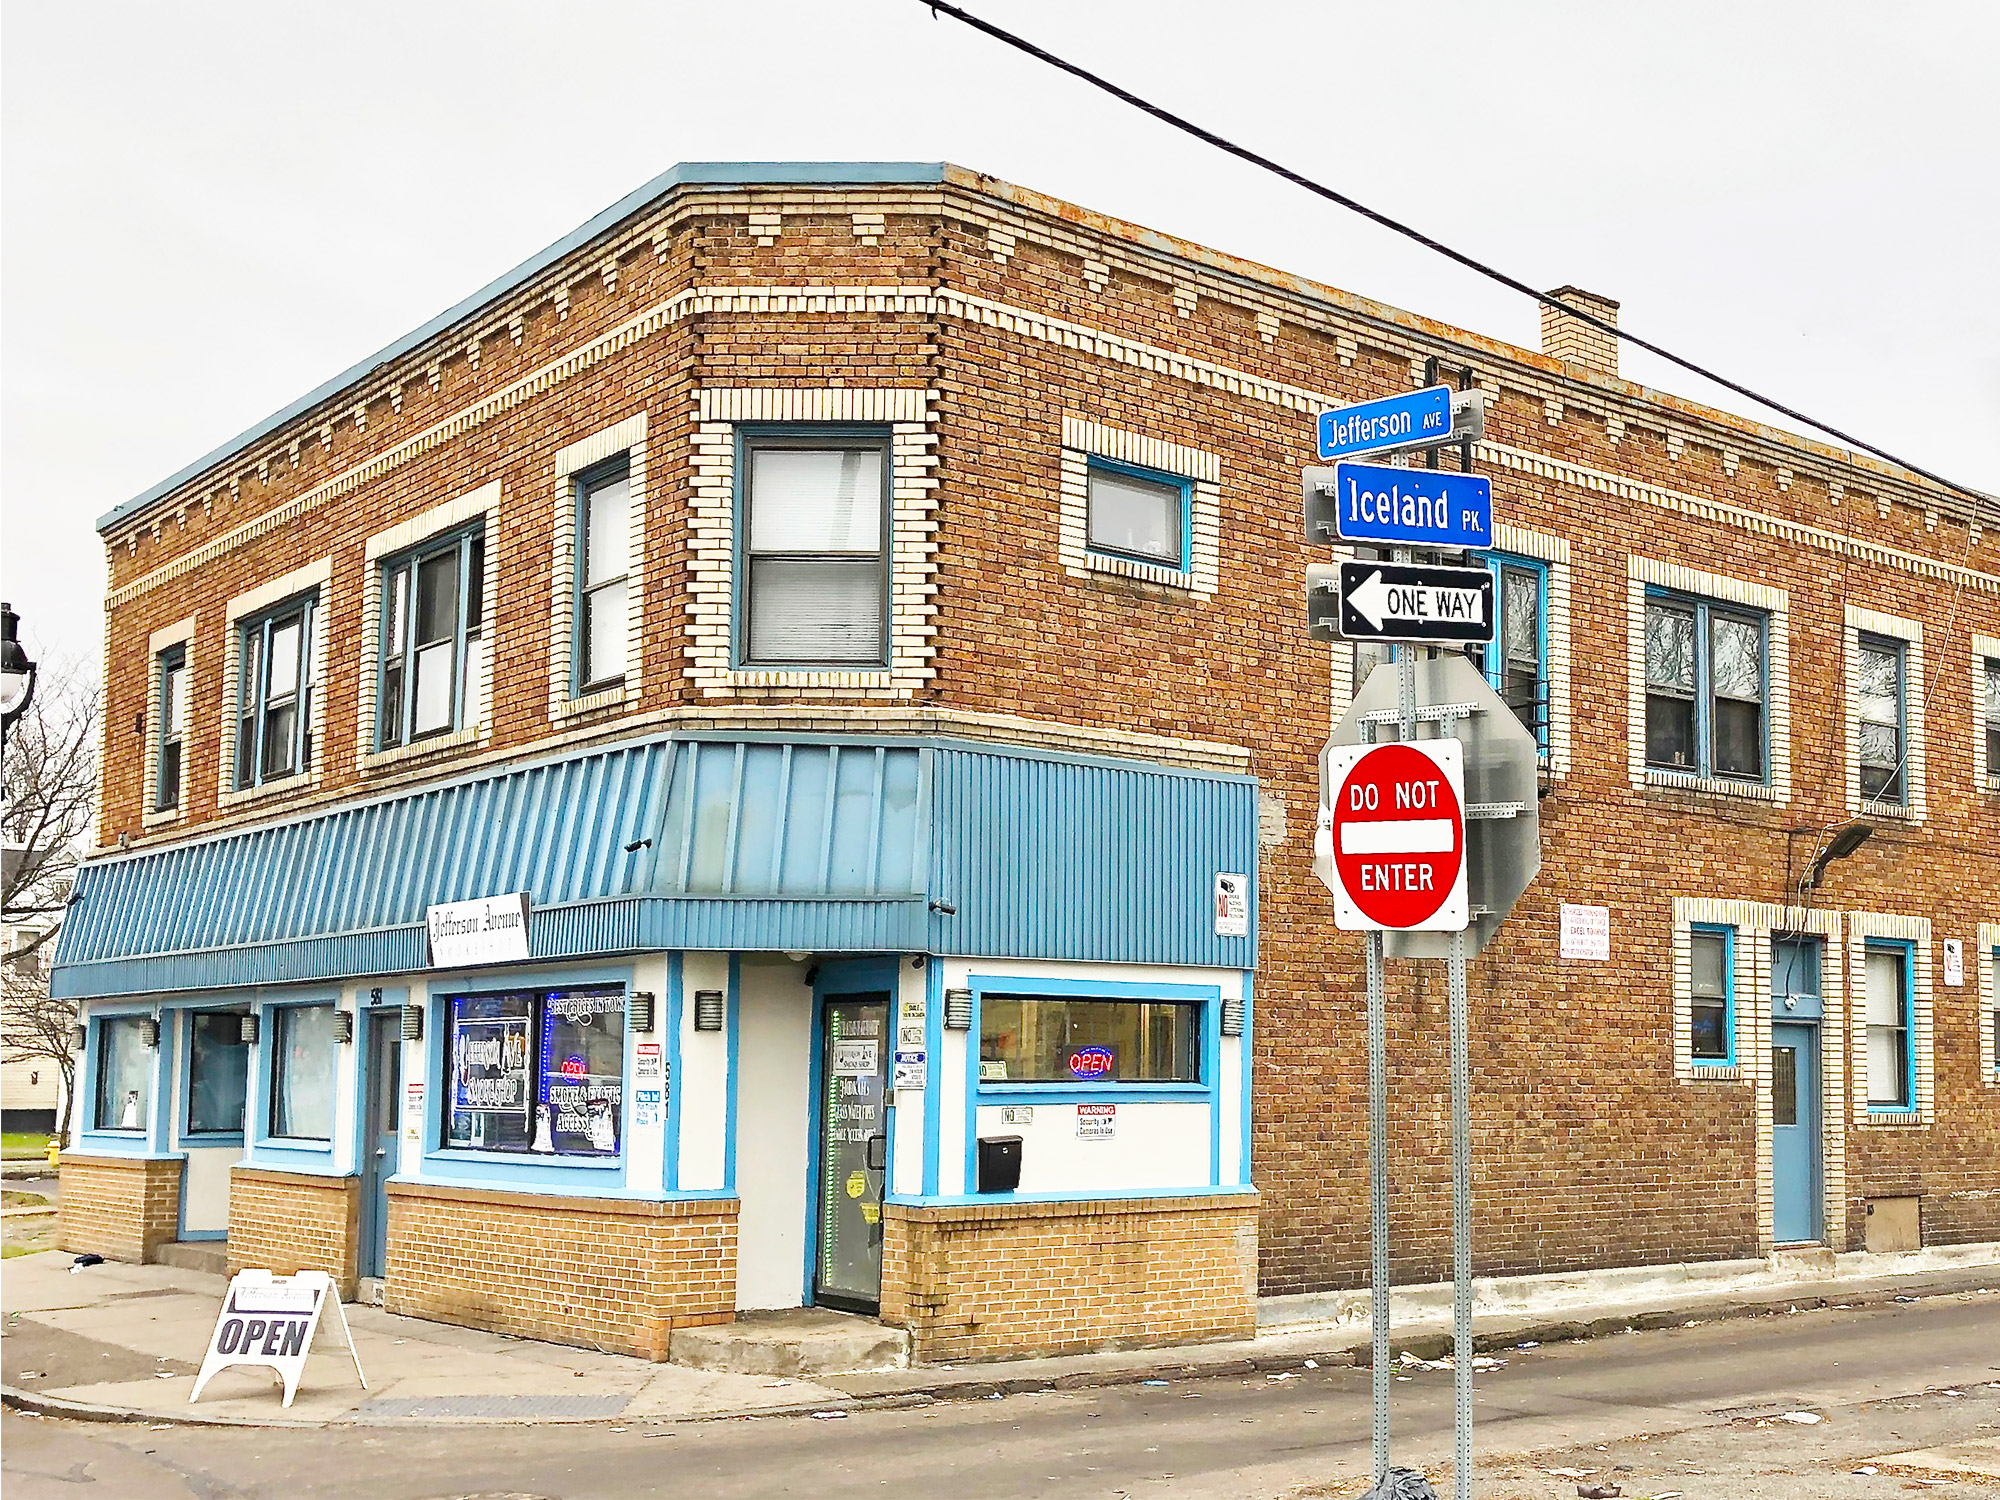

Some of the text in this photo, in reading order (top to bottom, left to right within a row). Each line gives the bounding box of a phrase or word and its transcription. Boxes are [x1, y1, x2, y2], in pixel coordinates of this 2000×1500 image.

[1327, 411, 1442, 449] Jefferson AVE
[1349, 479, 1448, 529] Iceland
[1387, 587, 1477, 620] ONE WAY
[1350, 780, 1439, 811] DO NOT
[1361, 863, 1434, 891] ENTER
[1218, 893, 1228, 918] NO
[433, 903, 520, 942] Jefferson Avenue
[1069, 1052, 1114, 1075] OPEN
[1004, 1109, 1015, 1122] NO
[1079, 1105, 1115, 1115] WARNING
[1079, 1117, 1100, 1127] Security
[217, 1318, 309, 1357] OPEN
